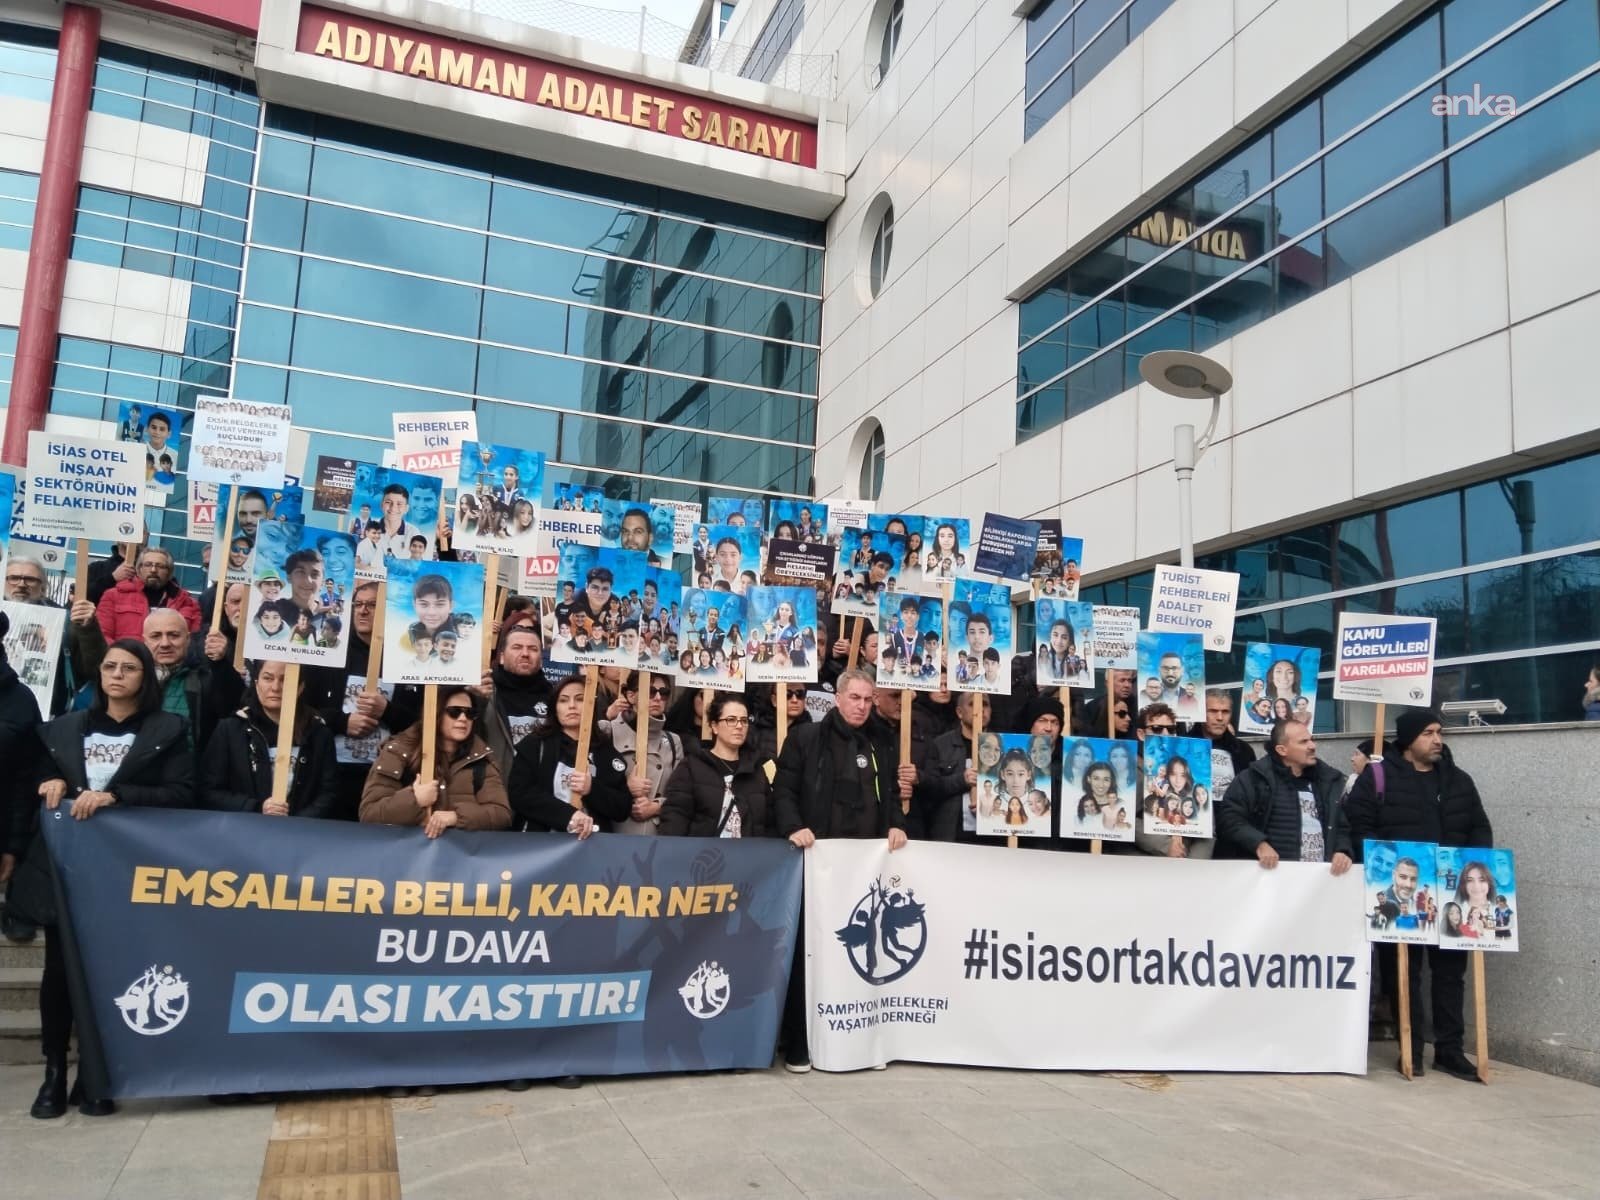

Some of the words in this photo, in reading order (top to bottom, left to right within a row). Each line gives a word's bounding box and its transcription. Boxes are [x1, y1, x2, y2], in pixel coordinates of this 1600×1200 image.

[315, 21, 528, 100] ADIYAMAN
[537, 72, 675, 132] ADALET
[681, 105, 801, 163] SARAYI
[398, 421, 469, 432] REHBERLER
[424, 434, 449, 447] İÇİN
[48, 442, 86, 459] İSİAS
[91, 449, 127, 463] OTEL
[406, 452, 461, 471] ADALE
[60, 460, 114, 478] İNŞAAT
[34, 476, 136, 497] SEKTÖRÜNÜN
[34, 493, 136, 514] FELAKETİDİR!
[539, 520, 600, 535] HBERLER
[1162, 572, 1202, 584] TURİST
[1160, 586, 1231, 602] REHBERLERİ
[1157, 600, 1203, 613] ADALET
[1156, 614, 1213, 629] BEKLİYOR
[1344, 628, 1385, 641] KAMU
[1343, 639, 1428, 657] GÖREVLİLERİ
[543, 667, 573, 676] APORUNU
[1342, 661, 1426, 677] YARGILANSIN
[131, 866, 385, 914] EMSALLER
[399, 870, 520, 922] BELLİ,
[528, 886, 661, 918] KARAR
[666, 882, 738, 916] NET:
[376, 929, 434, 963] BU
[444, 929, 550, 963] DAVA
[964, 928, 1357, 990] #isiasortakdavamız
[244, 981, 411, 1024] OLASI
[423, 980, 639, 1021] KASTTIR!
[817, 999, 878, 1018] ŞAMPİYON
[881, 996, 948, 1010] MELEKLERİ
[829, 1014, 880, 1034] YAŞATMA
[881, 1010, 936, 1024] DERNEĞİ
